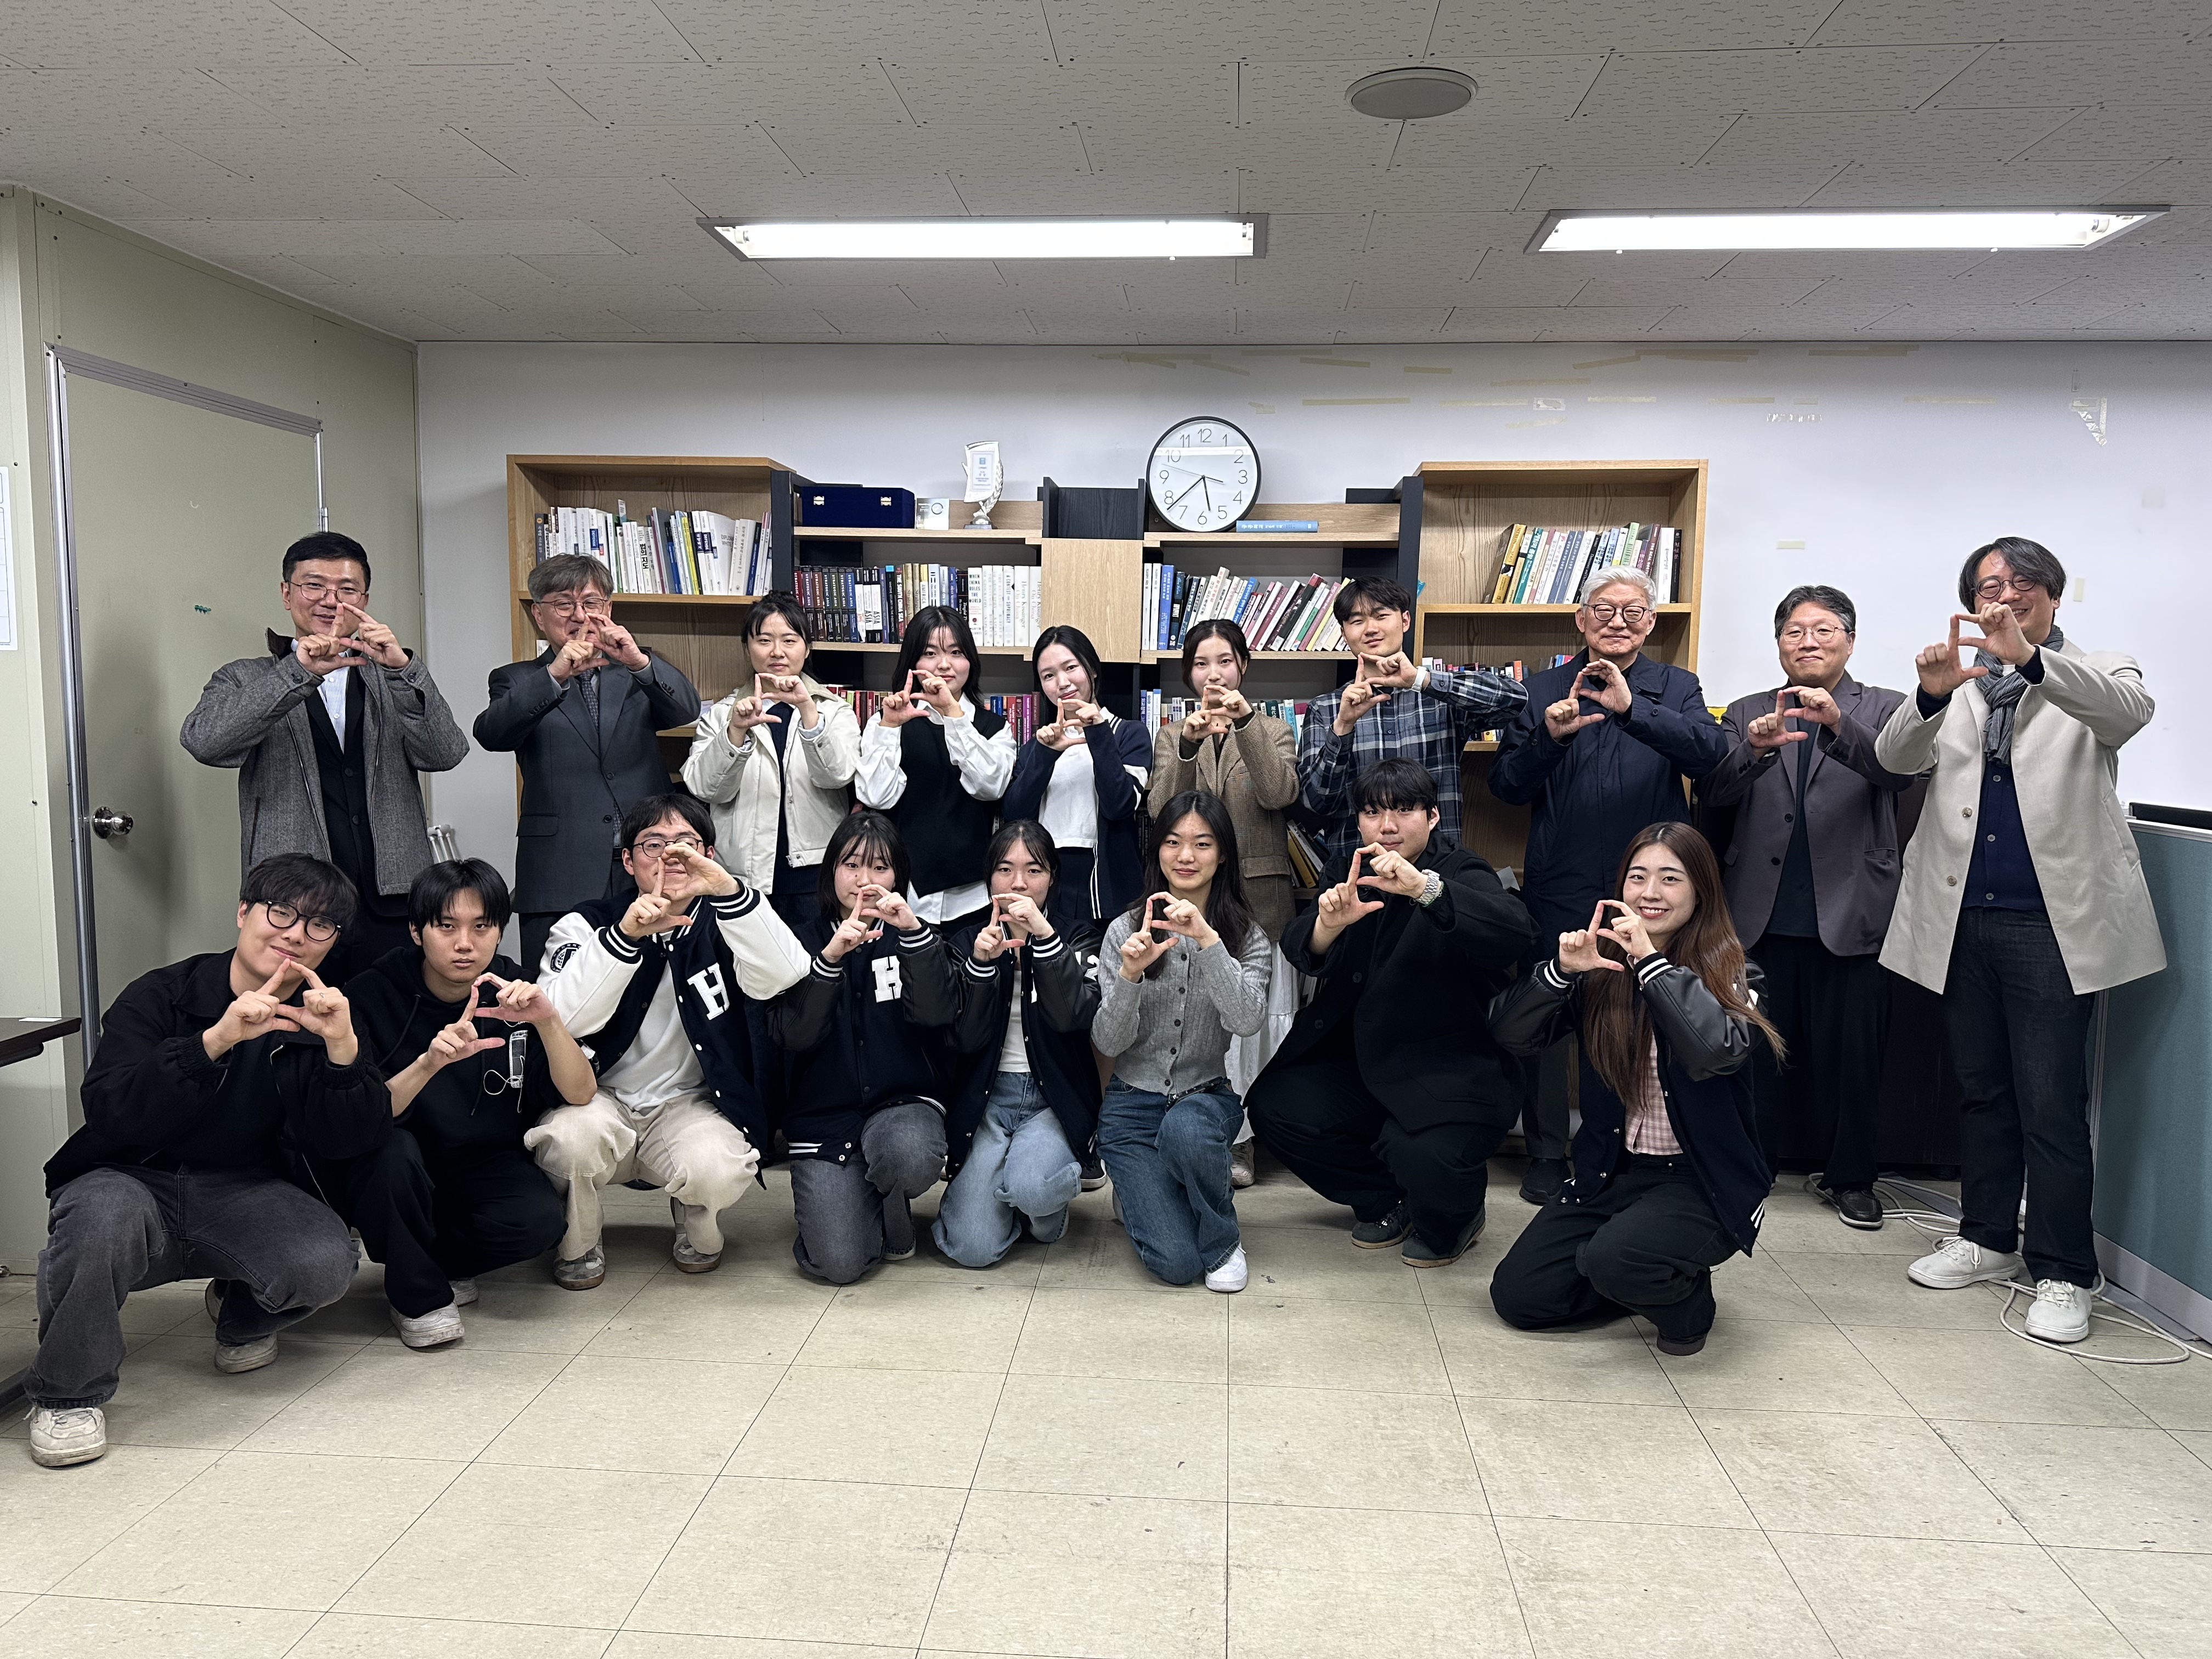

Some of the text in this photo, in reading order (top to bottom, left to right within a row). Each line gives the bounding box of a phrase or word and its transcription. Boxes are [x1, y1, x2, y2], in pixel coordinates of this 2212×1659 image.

[1180, 435, 1189, 448] 11
[1198, 429, 1211, 442] 12
[1223, 434, 1227, 447] 1
[1165, 450, 1181, 462] 10
[1234, 449, 1244, 463] 2
[1160, 470, 1169, 484] 9
[1238, 470, 1248, 484] 3
[1164, 490, 1173, 504] 8
[1233, 490, 1242, 504] 4
[1178, 506, 1188, 519] 7
[1198, 511, 1207, 524] 6
[1218, 506, 1227, 519] 5
[1015, 590, 1020, 599] On
[1031, 590, 1036, 599] On
[871, 955, 903, 1003] H
[687, 962, 730, 1020] H
